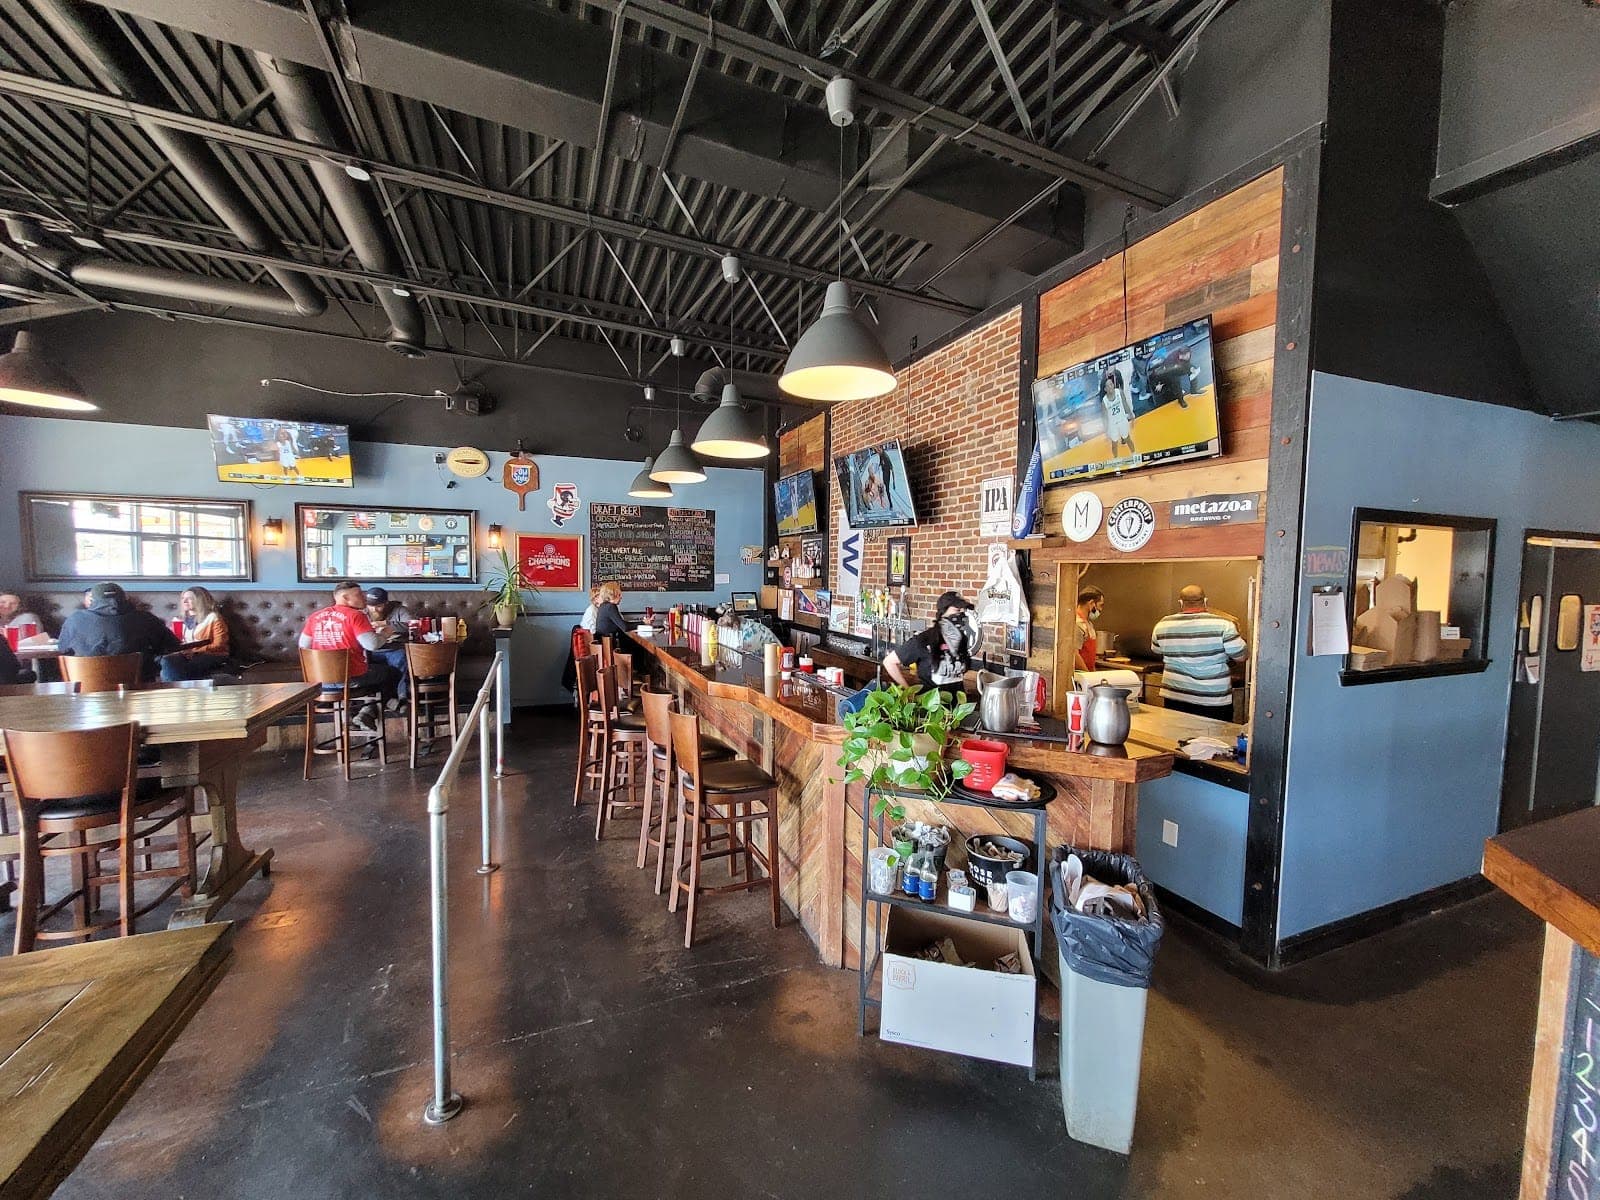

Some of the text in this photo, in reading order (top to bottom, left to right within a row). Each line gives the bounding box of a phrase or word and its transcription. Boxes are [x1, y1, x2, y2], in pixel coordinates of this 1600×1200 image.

[594, 504, 638, 516] DRAFT BEER
[984, 487, 1008, 512] IPA
[1174, 500, 1252, 515] metazoa
[1109, 500, 1153, 523] CENTERPOINT
[528, 557, 570, 567] CHAMPIONS
[632, 547, 643, 555] ALE
[842, 533, 859, 577] W
[1576, 1052, 1596, 1090] 2
[1573, 1084, 1598, 1133] 3
